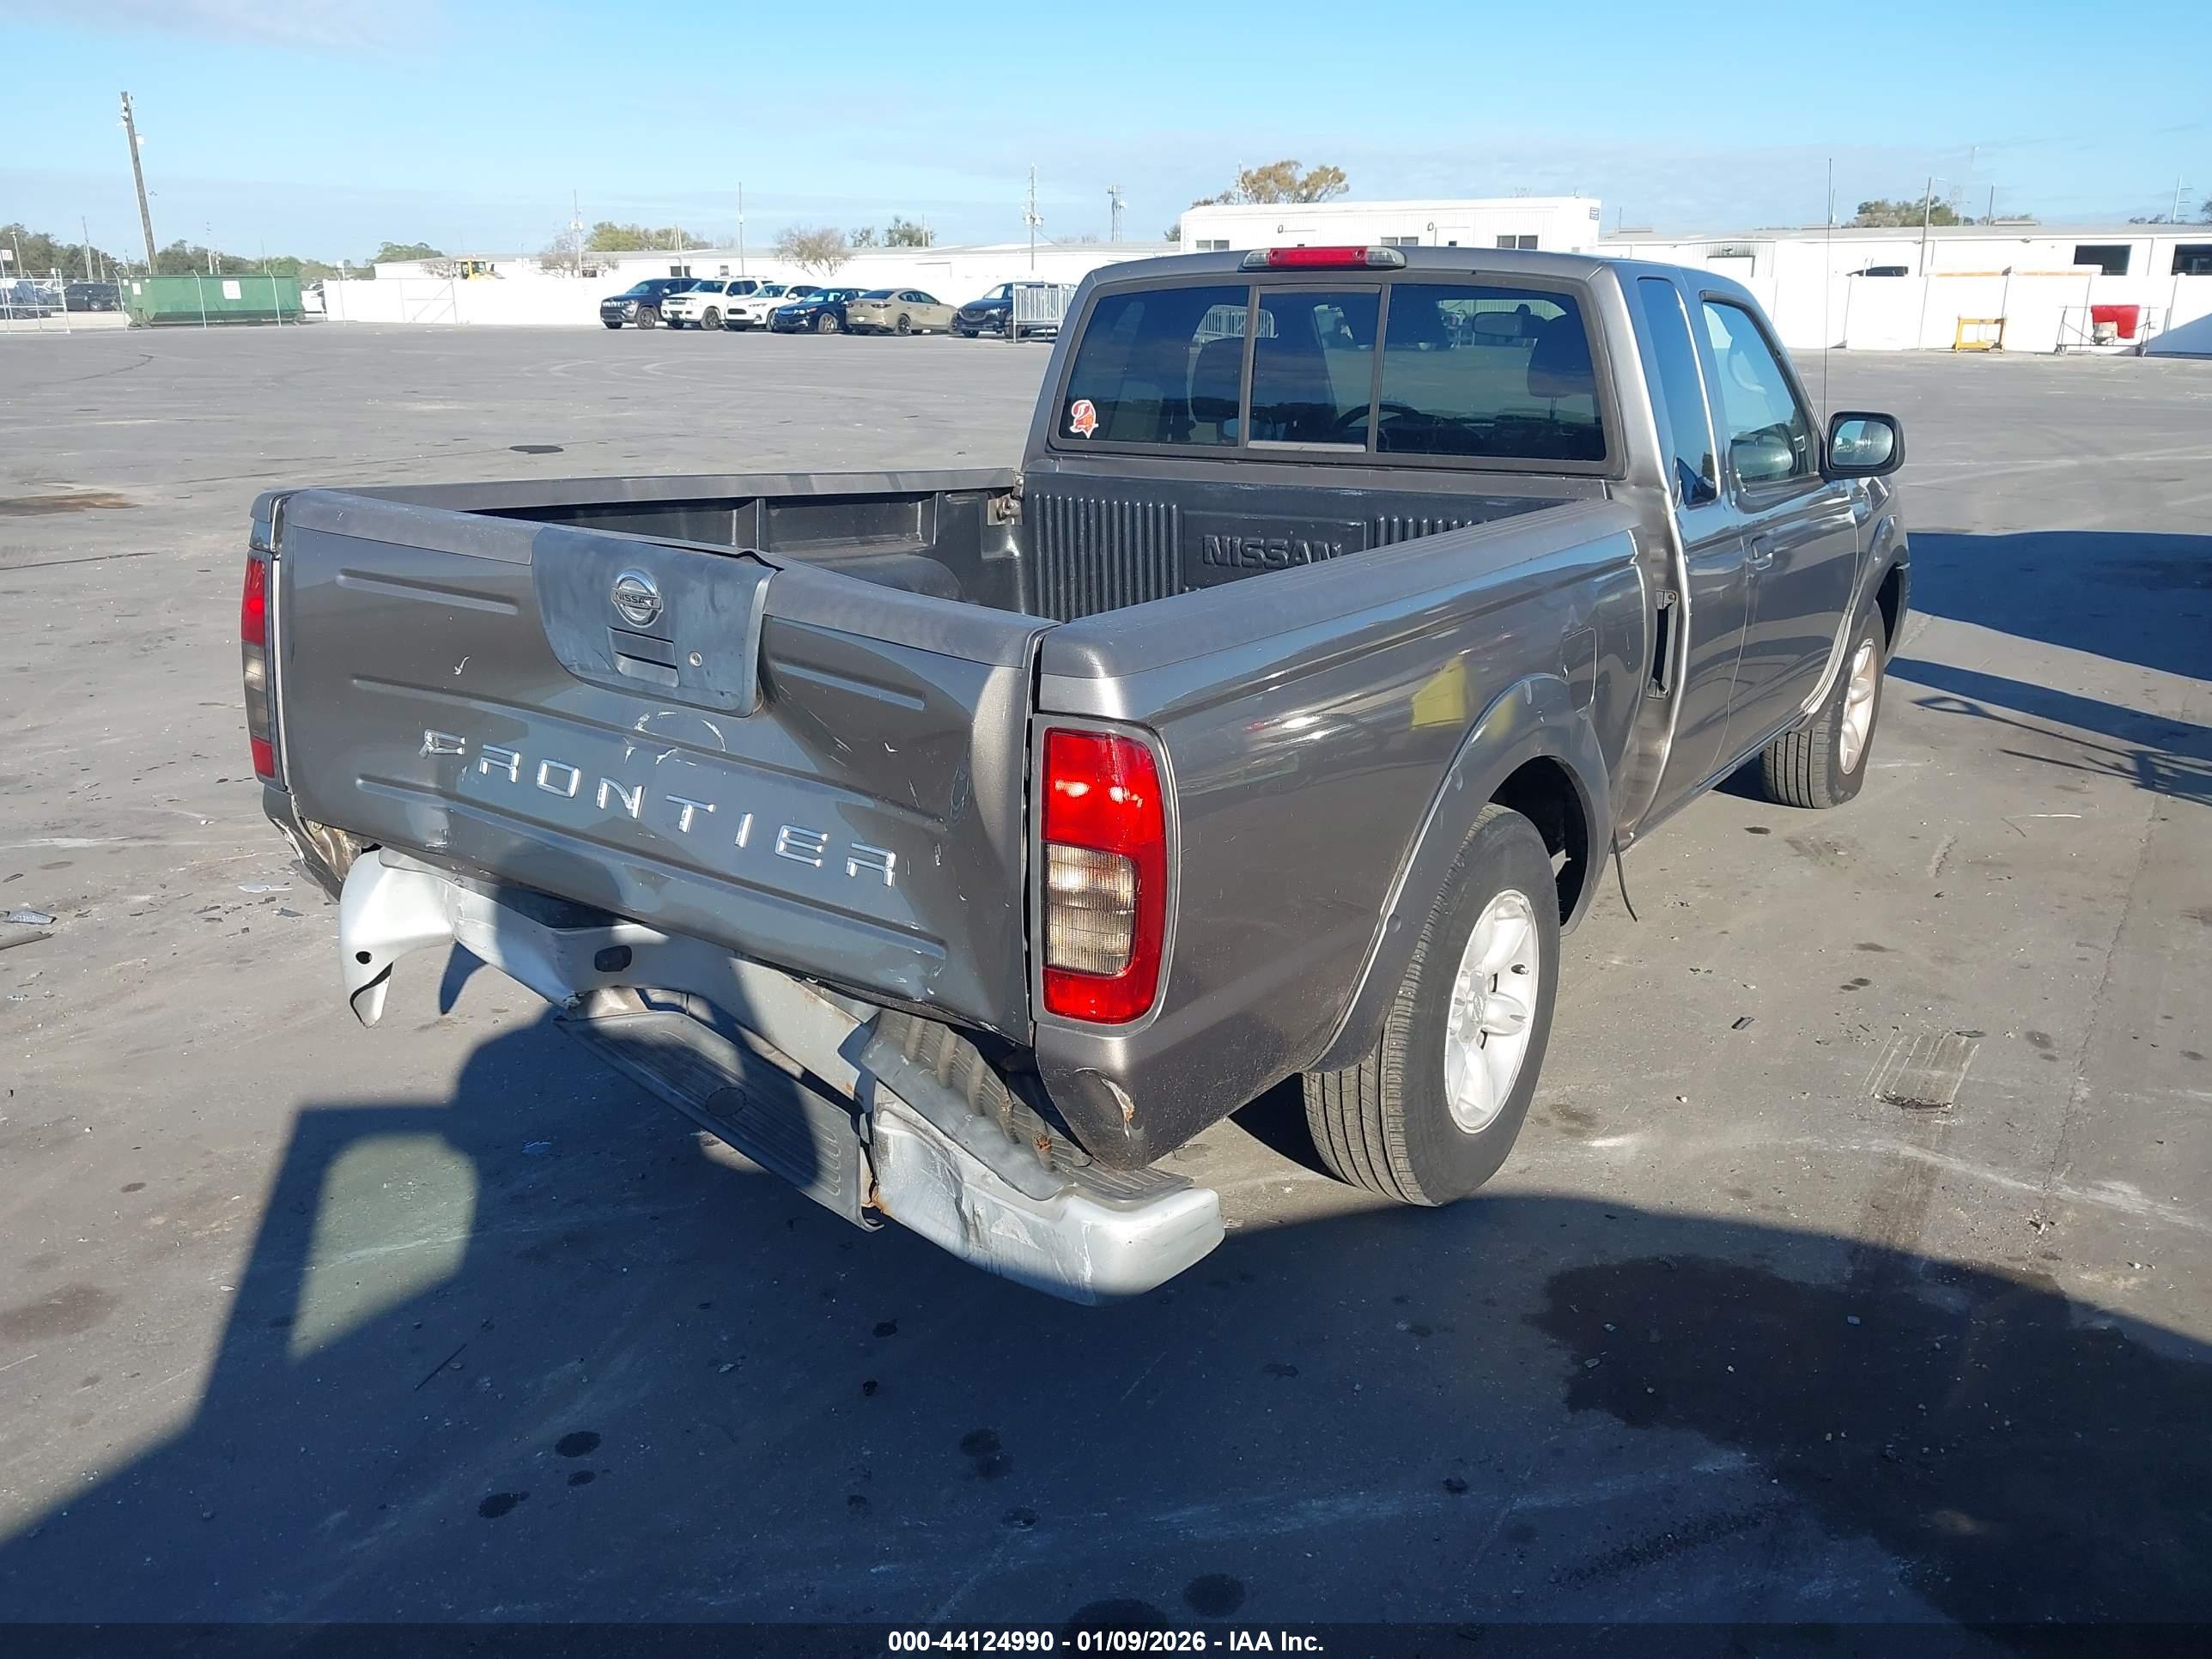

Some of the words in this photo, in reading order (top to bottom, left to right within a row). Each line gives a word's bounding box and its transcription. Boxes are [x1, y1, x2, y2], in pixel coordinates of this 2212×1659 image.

[1202, 535, 1341, 569] NISSAN
[615, 591, 654, 606] NISSAN
[418, 728, 897, 887] FRONTIER
